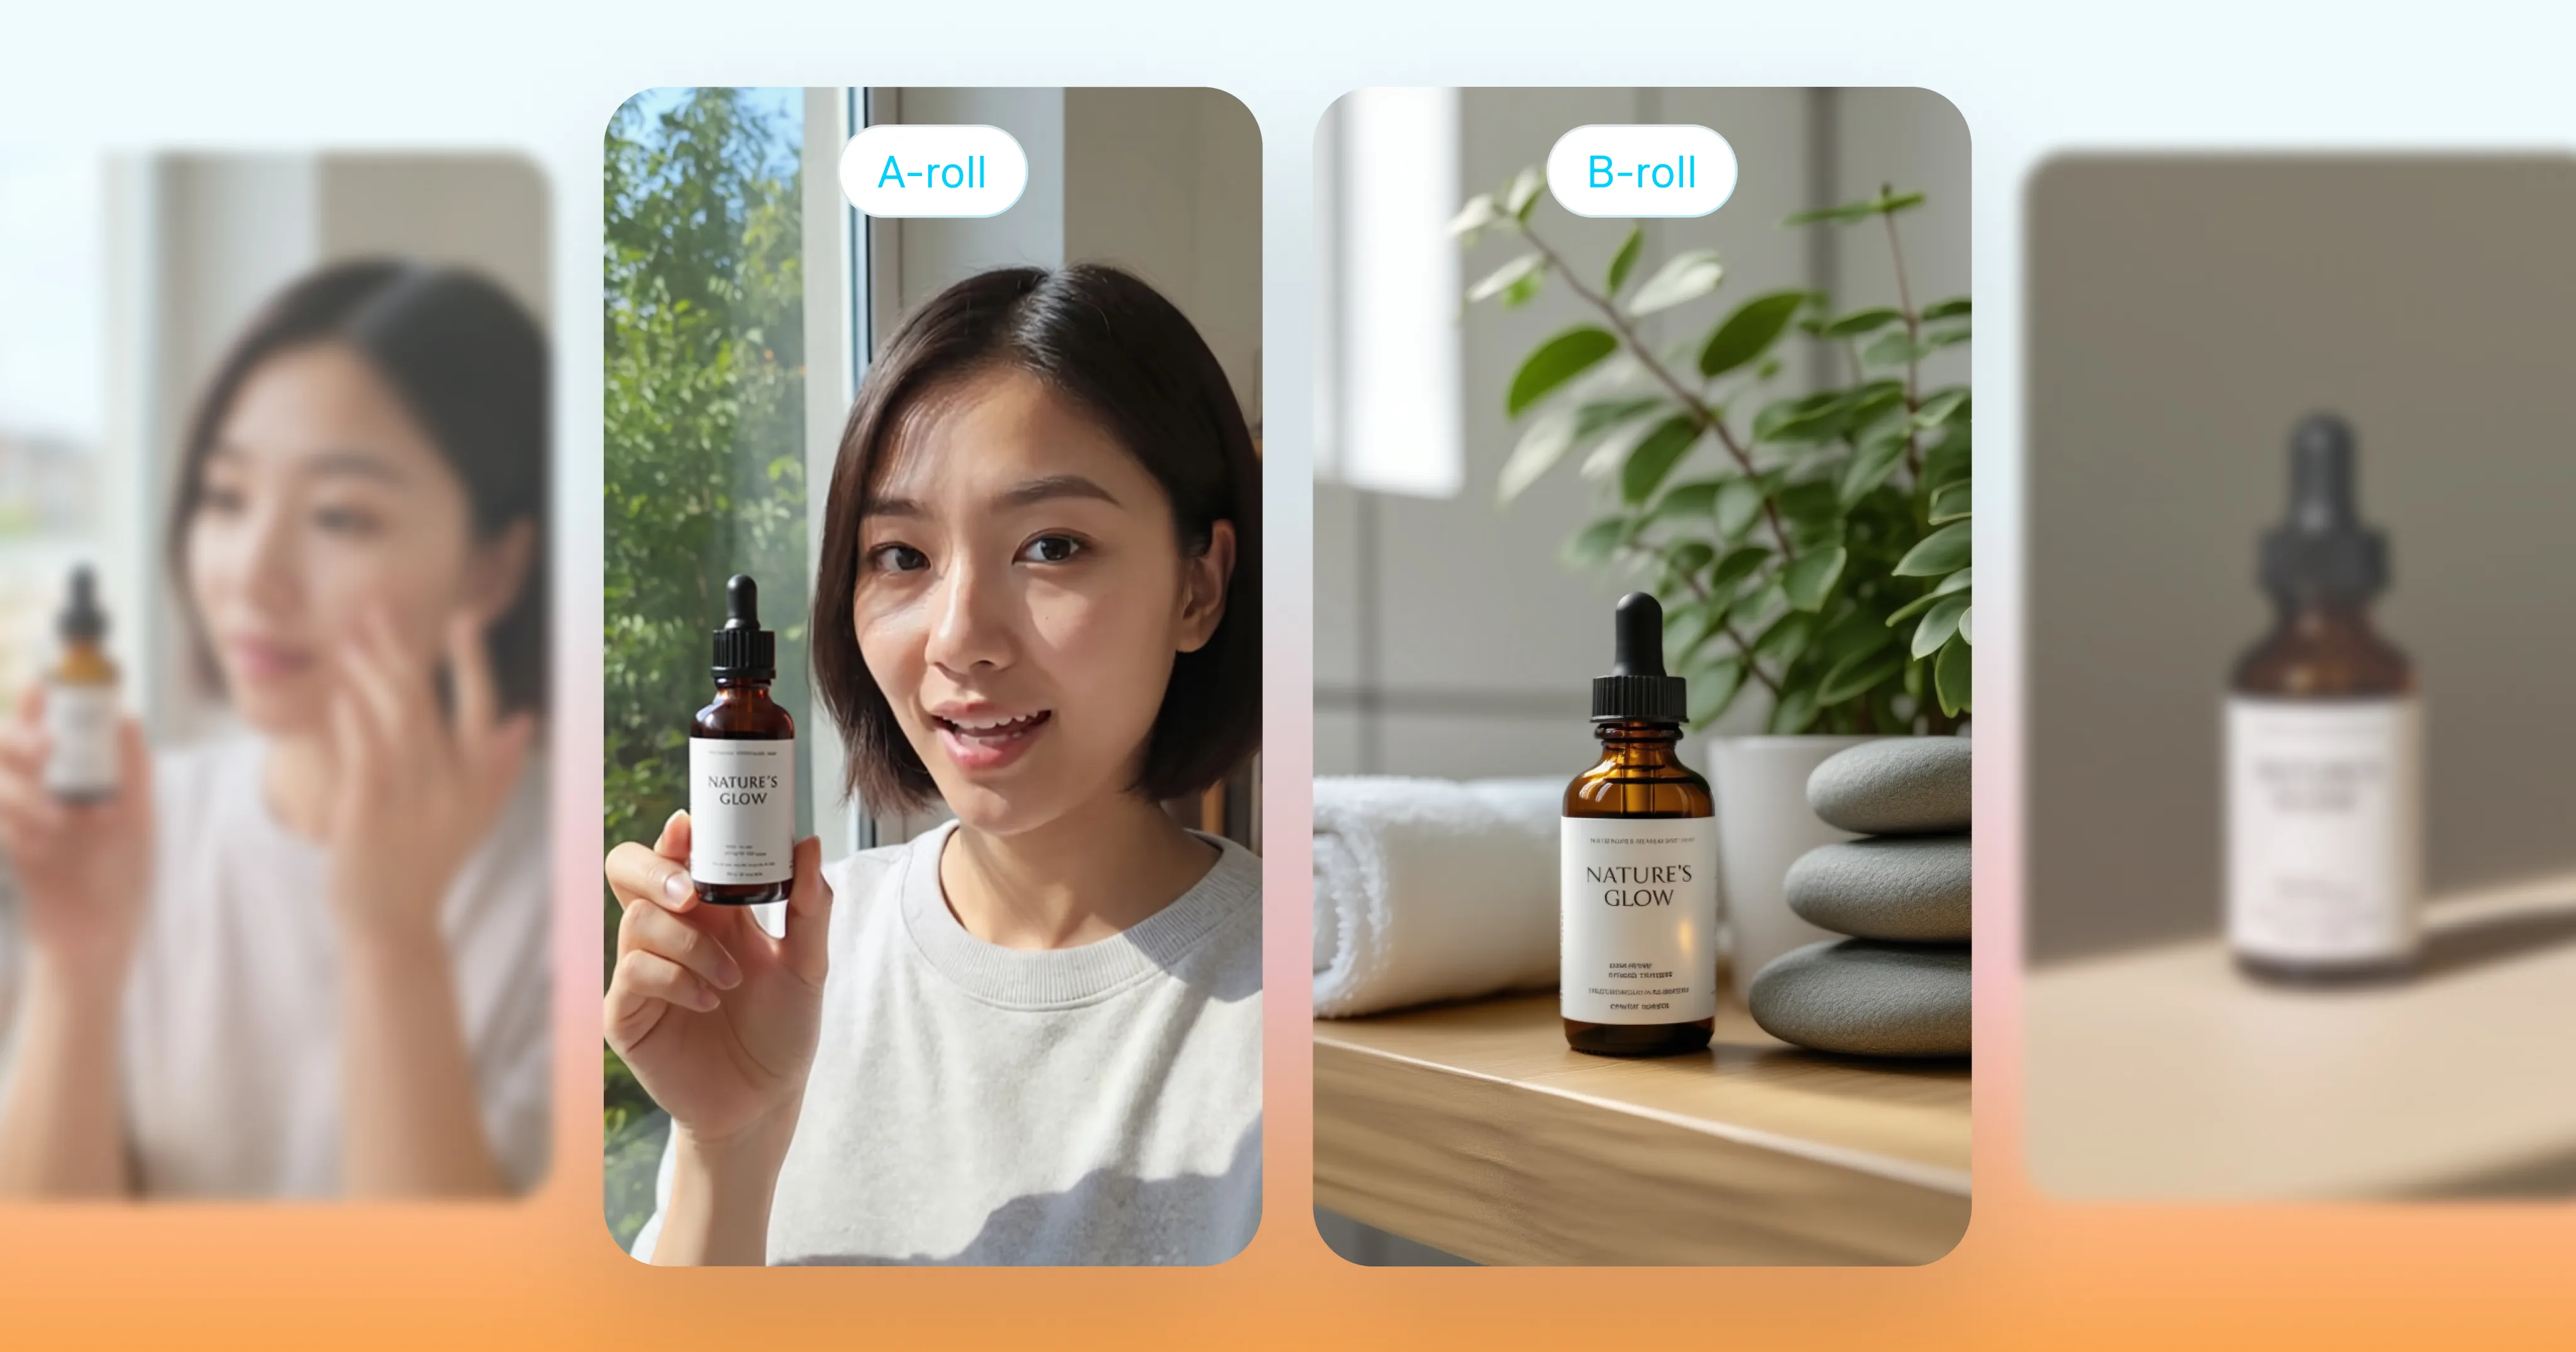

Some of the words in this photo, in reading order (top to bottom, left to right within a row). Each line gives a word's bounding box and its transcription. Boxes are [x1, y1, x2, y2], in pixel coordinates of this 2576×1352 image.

[708, 775, 778, 789] NATURE'S
[719, 792, 768, 806] GLOW
[1587, 865, 1692, 884] NATURE'S
[1604, 889, 1674, 907] GLOW
